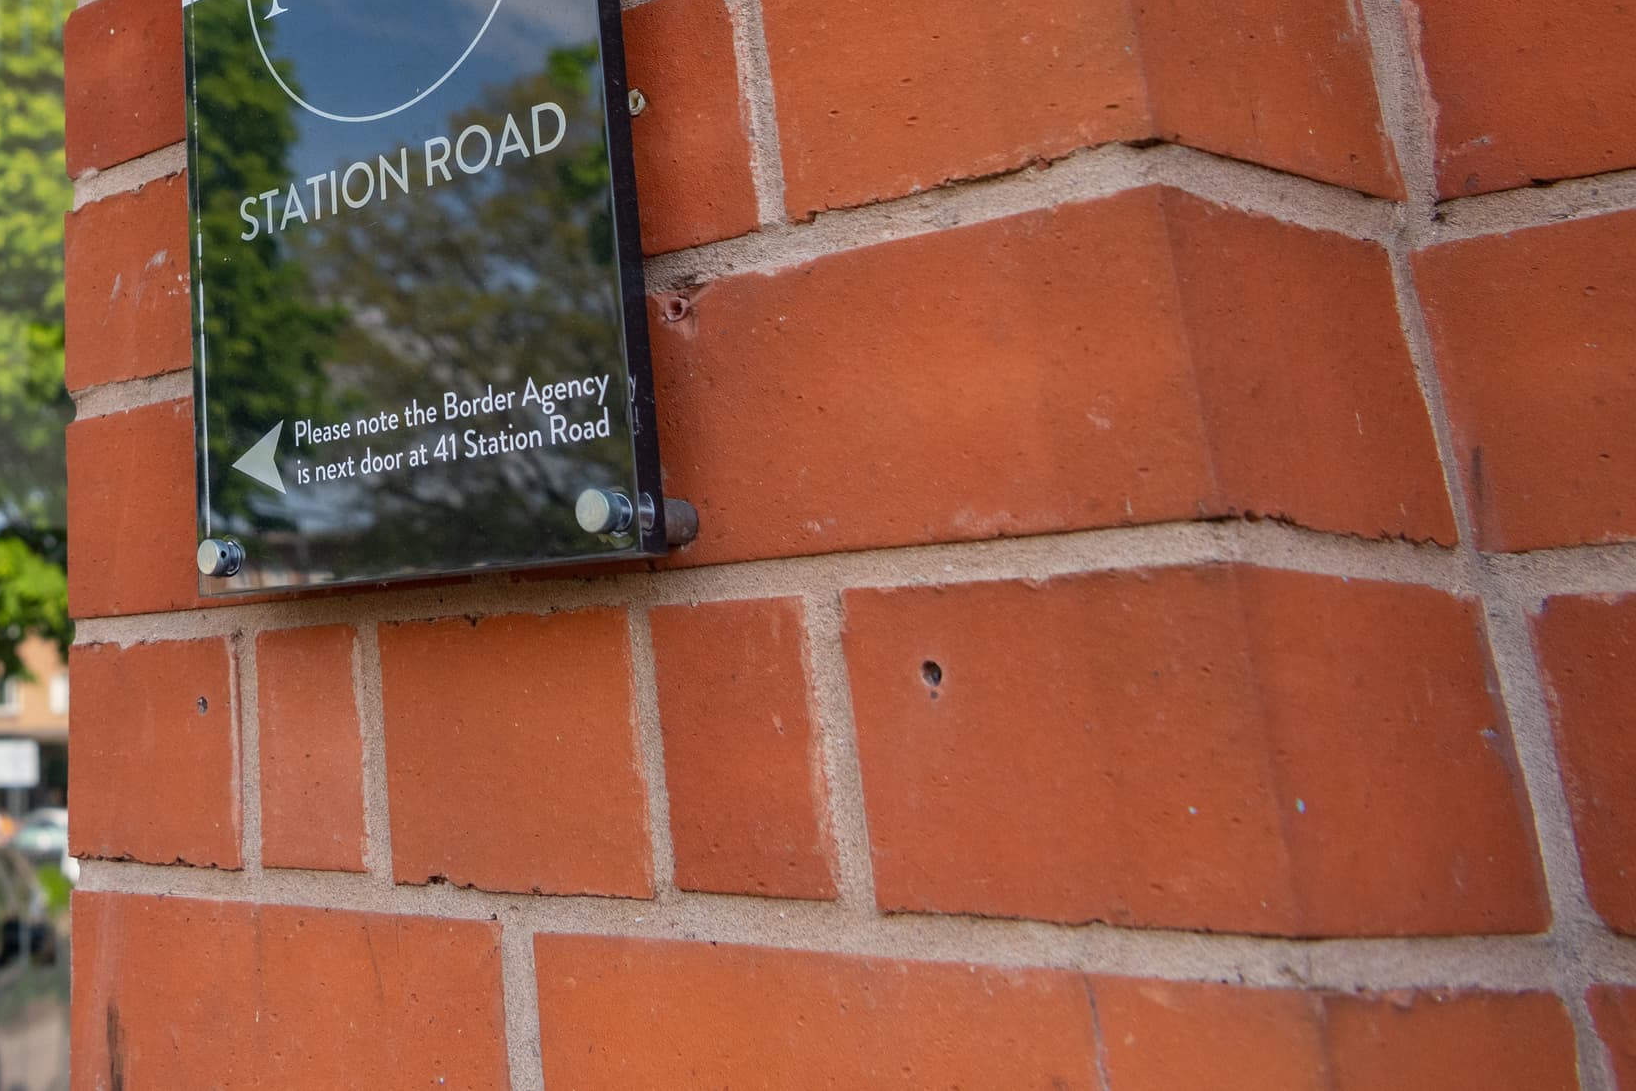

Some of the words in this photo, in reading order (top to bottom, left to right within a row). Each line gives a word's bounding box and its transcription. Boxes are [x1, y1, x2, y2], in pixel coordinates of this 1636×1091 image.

[239, 147, 409, 242] STATION
[424, 101, 567, 187] ROAD
[294, 419, 351, 447] Please
[356, 411, 399, 438] note
[403, 399, 438, 428] the
[443, 383, 516, 421] Border
[521, 373, 610, 415] Agency
[296, 460, 311, 485] is
[315, 455, 355, 482] next
[359, 447, 404, 476] door
[408, 442, 429, 467] at
[432, 433, 458, 463] 41
[463, 423, 543, 459] Station
[549, 406, 611, 446] Road
